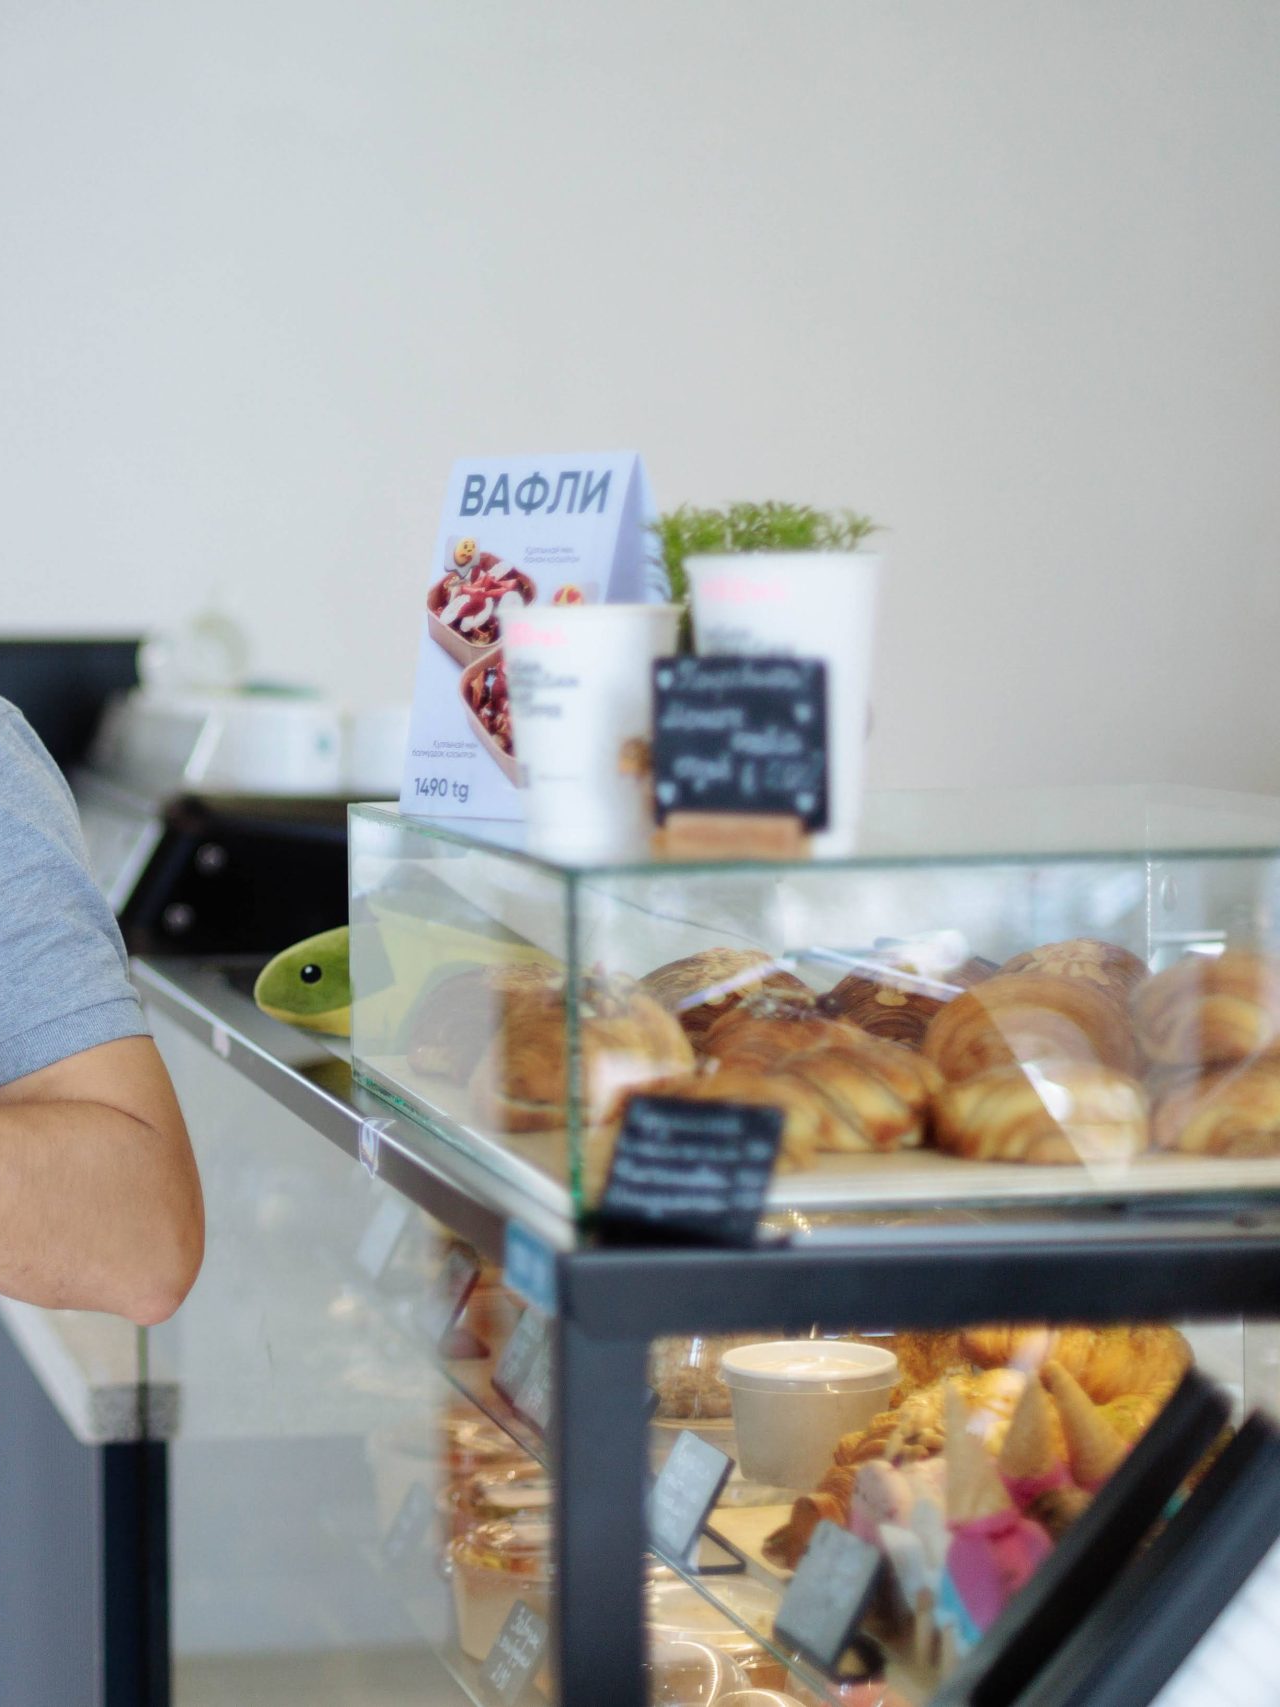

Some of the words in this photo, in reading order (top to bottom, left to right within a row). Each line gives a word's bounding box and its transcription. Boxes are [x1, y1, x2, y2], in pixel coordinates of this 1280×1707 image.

[459, 469, 613, 517] ВАФЛИ
[414, 777, 448, 797] 1490
[452, 781, 469, 803] tg
